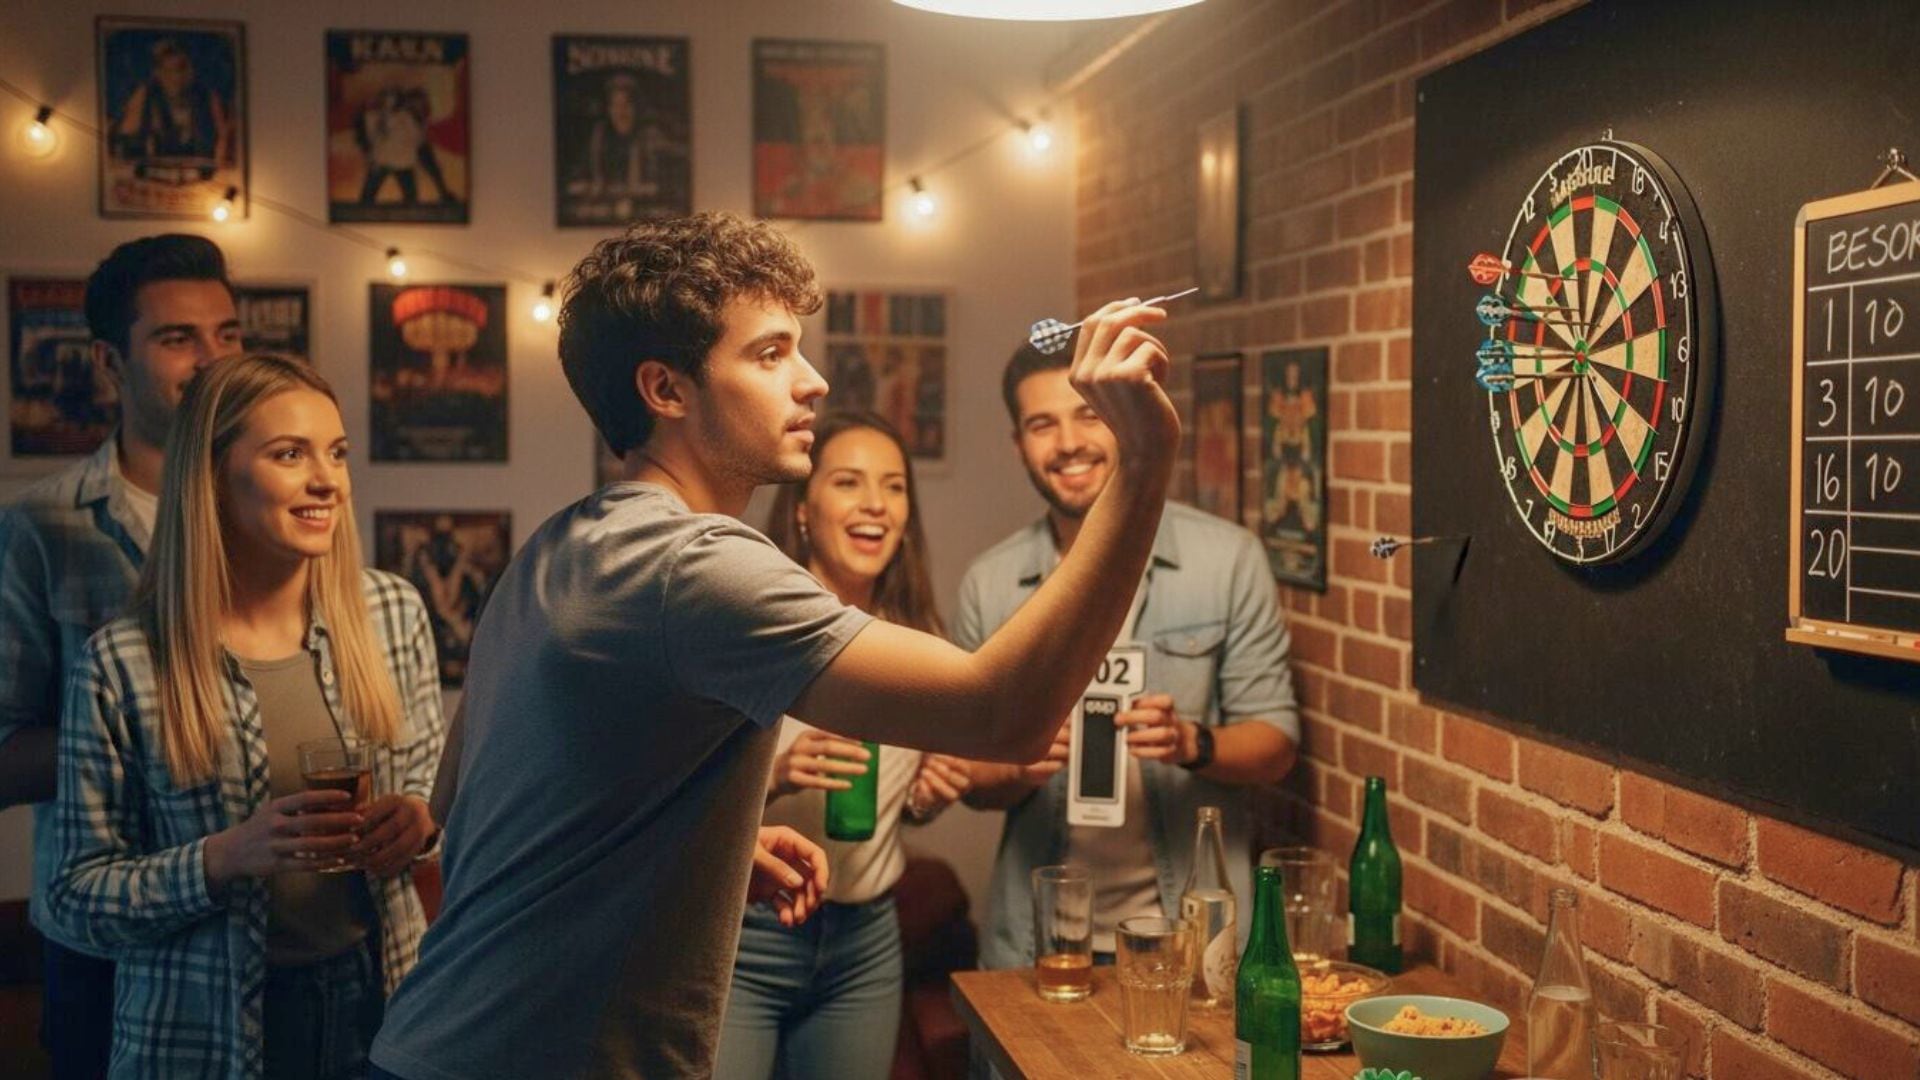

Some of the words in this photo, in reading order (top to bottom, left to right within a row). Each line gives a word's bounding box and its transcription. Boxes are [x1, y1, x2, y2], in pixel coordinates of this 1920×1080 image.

[1826, 297, 1834, 353] 1
[1864, 298, 1905, 345] 10
[1818, 378, 1837, 428] 3
[1864, 375, 1905, 425] 10
[1816, 452, 1841, 505] 16
[1865, 452, 1902, 502] 10
[1807, 527, 1846, 580] 20
